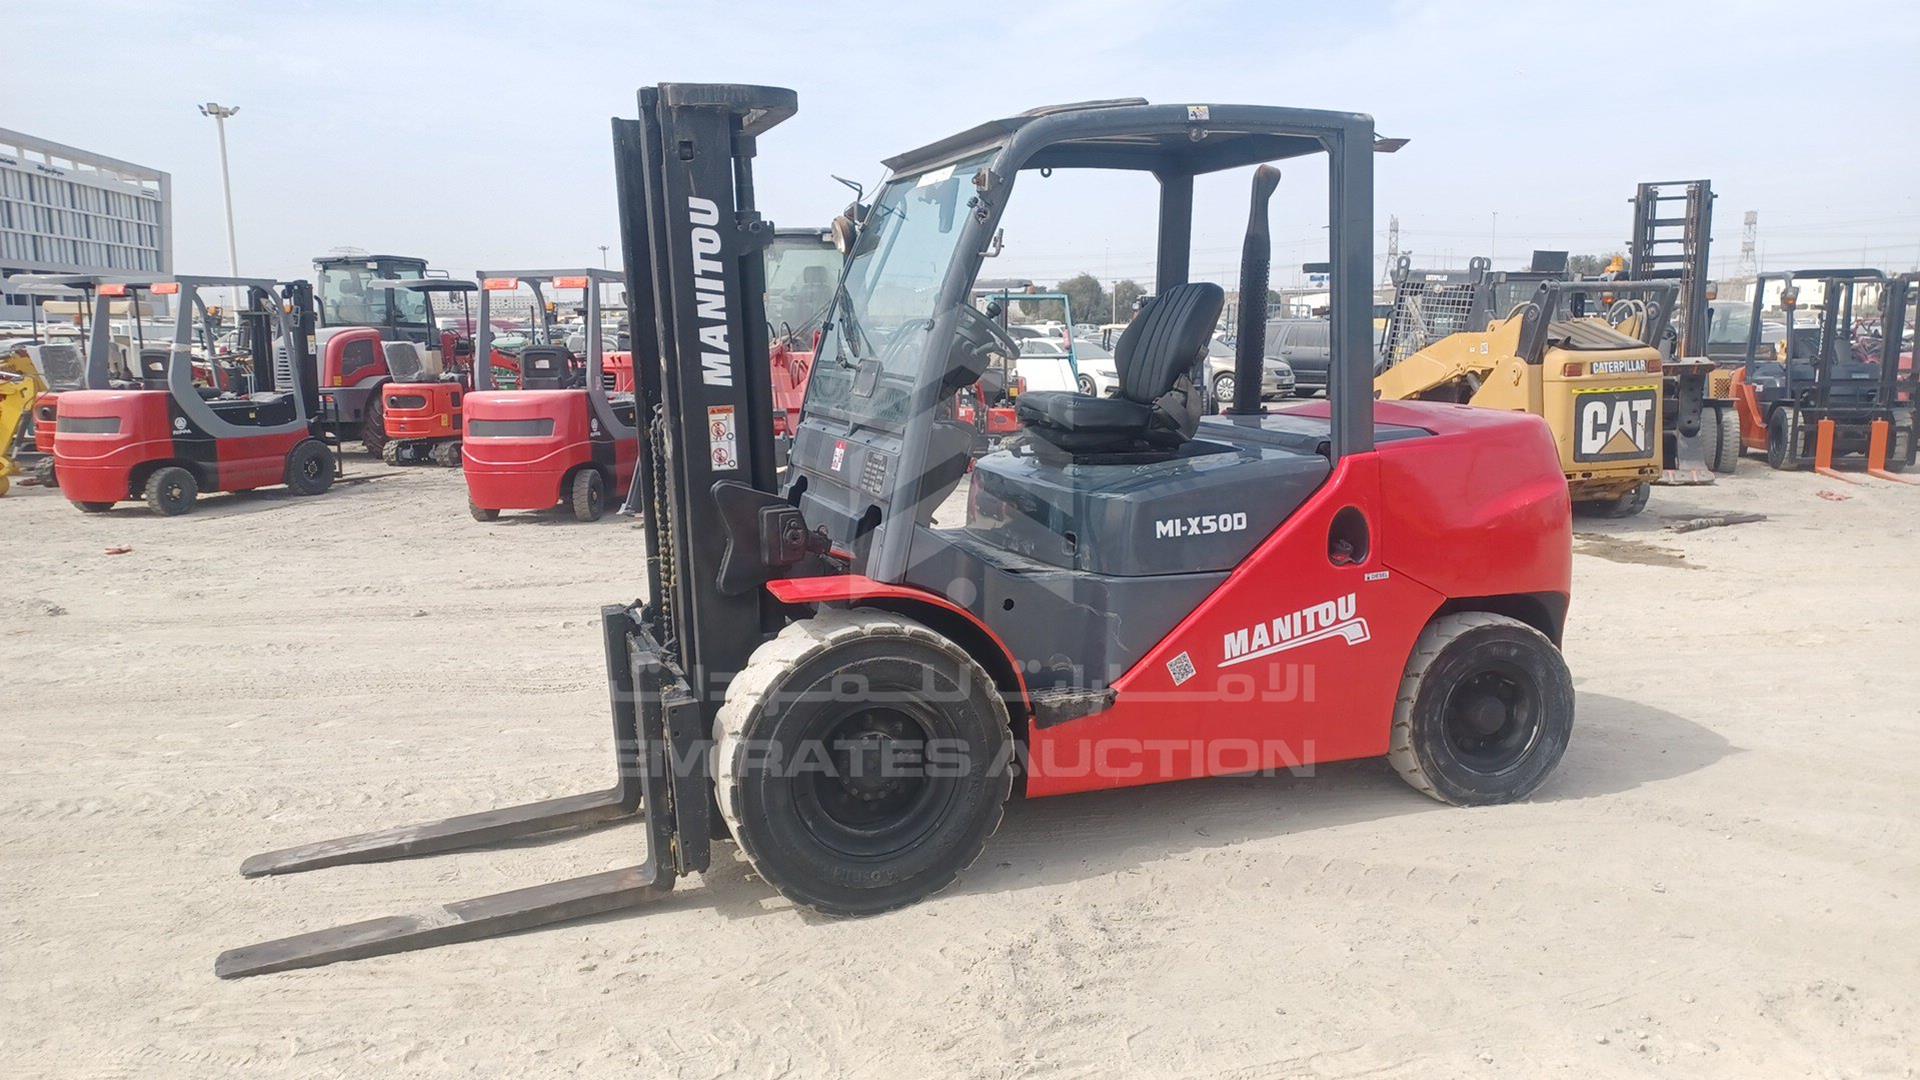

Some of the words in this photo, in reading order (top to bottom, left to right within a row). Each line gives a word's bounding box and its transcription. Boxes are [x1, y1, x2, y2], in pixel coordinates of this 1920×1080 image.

[688, 196, 733, 387] MANITOU
[1592, 359, 1646, 374] CATERPILLAR
[1581, 399, 1652, 455] CAT
[1155, 512, 1247, 539] MI-X50D
[1223, 592, 1357, 660] MANITOU
